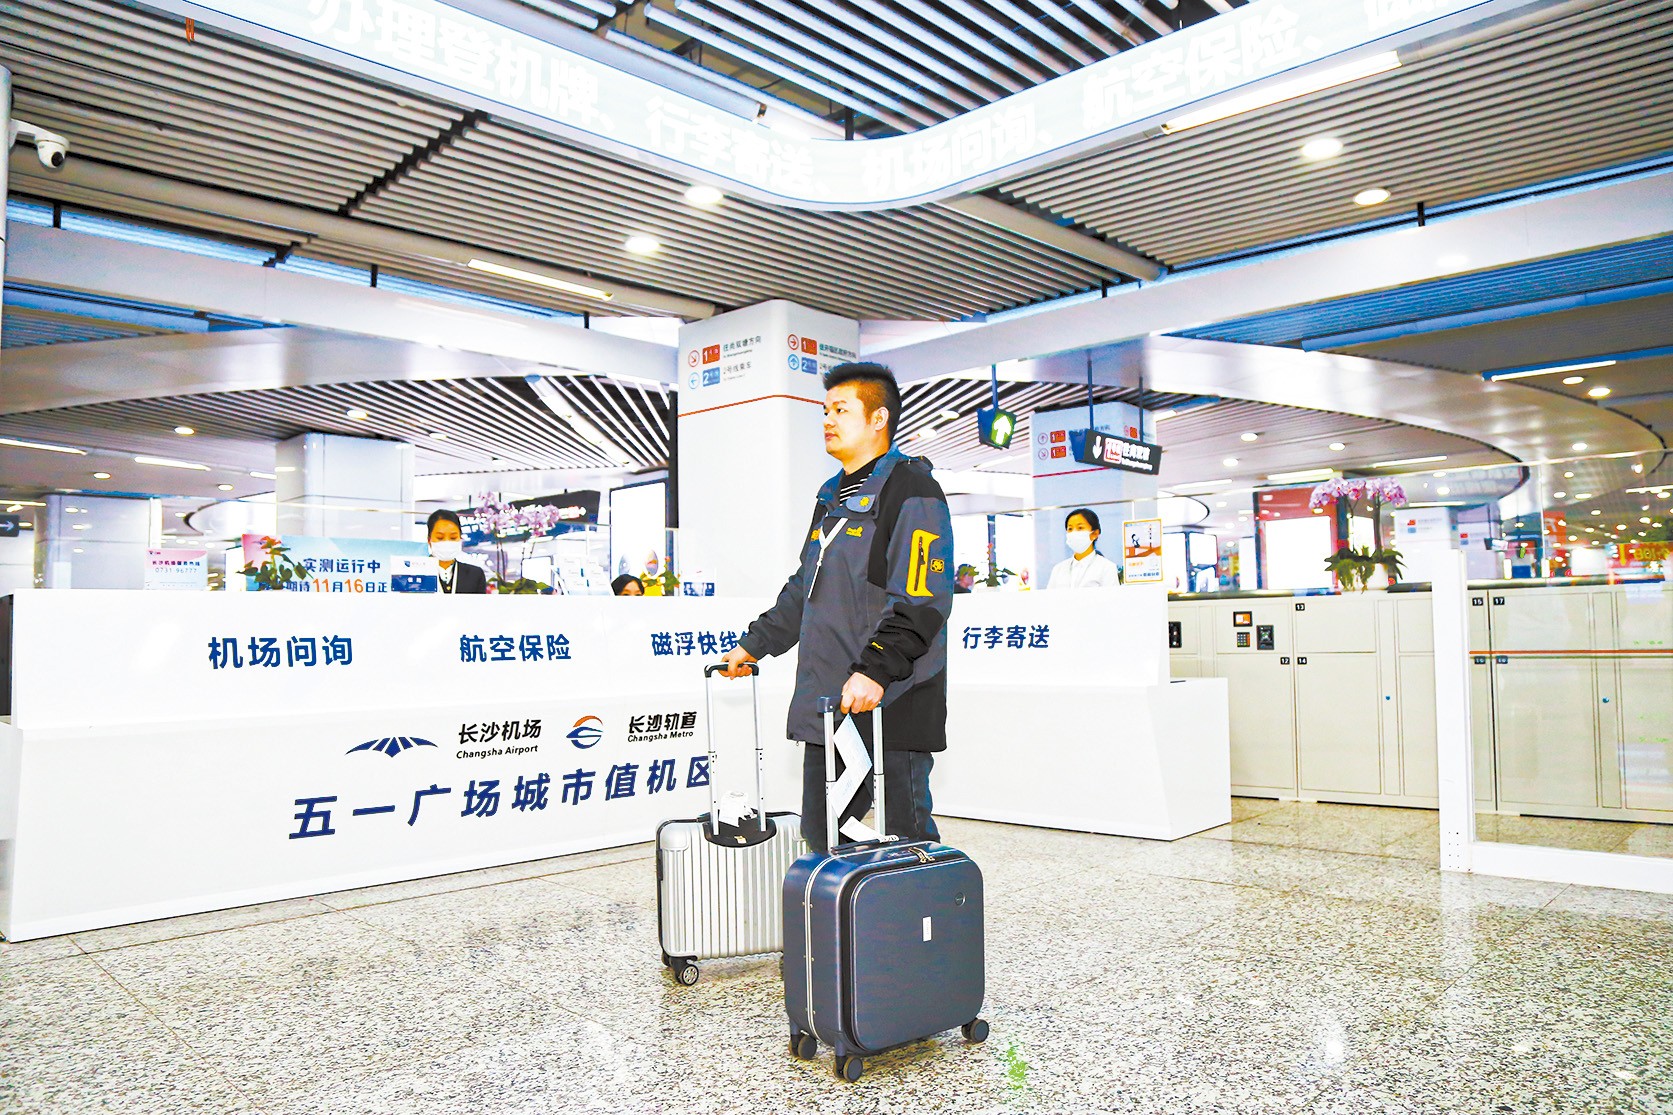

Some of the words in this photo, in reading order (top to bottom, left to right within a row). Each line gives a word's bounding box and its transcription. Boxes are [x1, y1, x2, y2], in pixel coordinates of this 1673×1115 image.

[303, 557, 381, 574] 实测运行中
[459, 633, 572, 663] 航空保险
[650, 630, 749, 657] 磁浮快线
[962, 624, 1050, 650] 行李寄送
[207, 634, 353, 670] 机场问询
[458, 718, 542, 745] 长沙机场
[628, 711, 698, 734] 长沙轨道
[627, 732, 669, 743] Changsha
[669, 730, 694, 739] Metro
[455, 747, 503, 760] Changsha
[504, 744, 539, 756] Airport
[288, 755, 710, 840] 五一广场城市值机区
